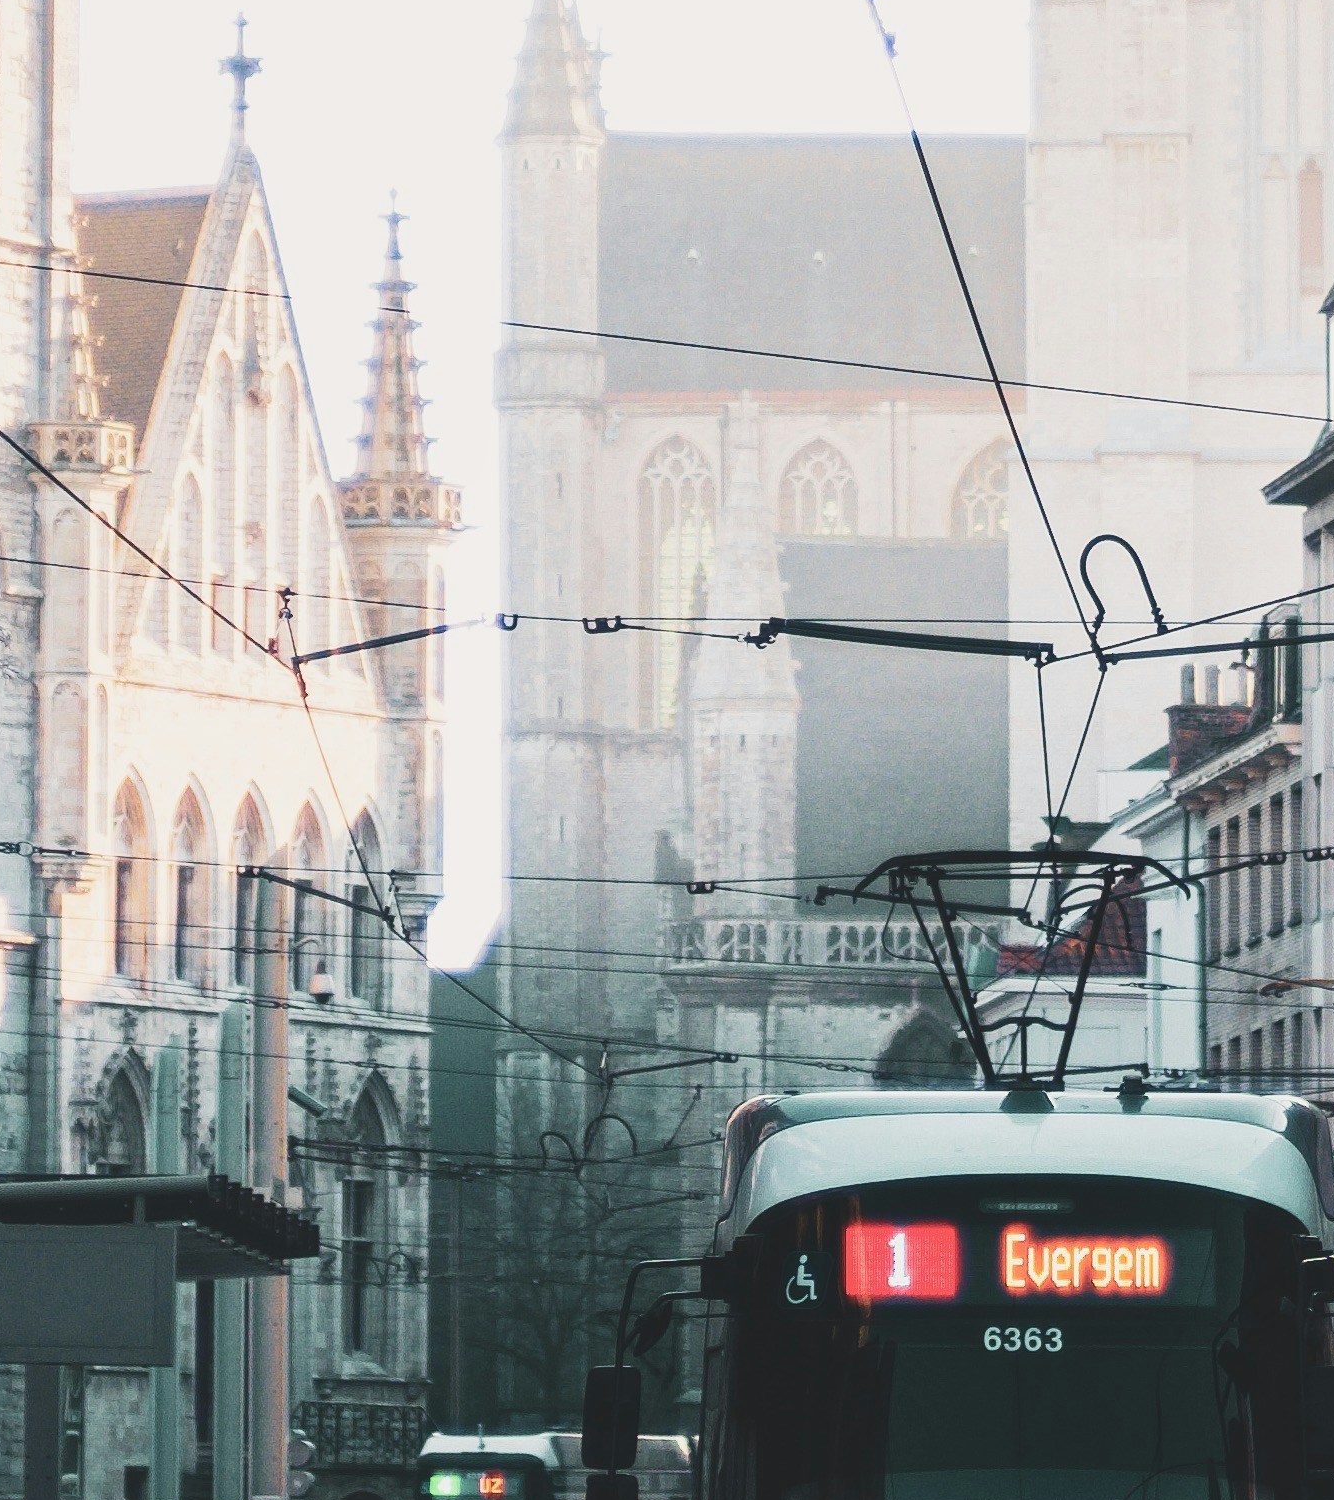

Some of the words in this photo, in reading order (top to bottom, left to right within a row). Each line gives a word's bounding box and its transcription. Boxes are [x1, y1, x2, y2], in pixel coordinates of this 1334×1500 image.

[887, 1231, 912, 1288] 1
[1005, 1232, 1161, 1289] Evergem
[983, 1326, 1064, 1353] 6363
[479, 1477, 505, 1494] UZ
